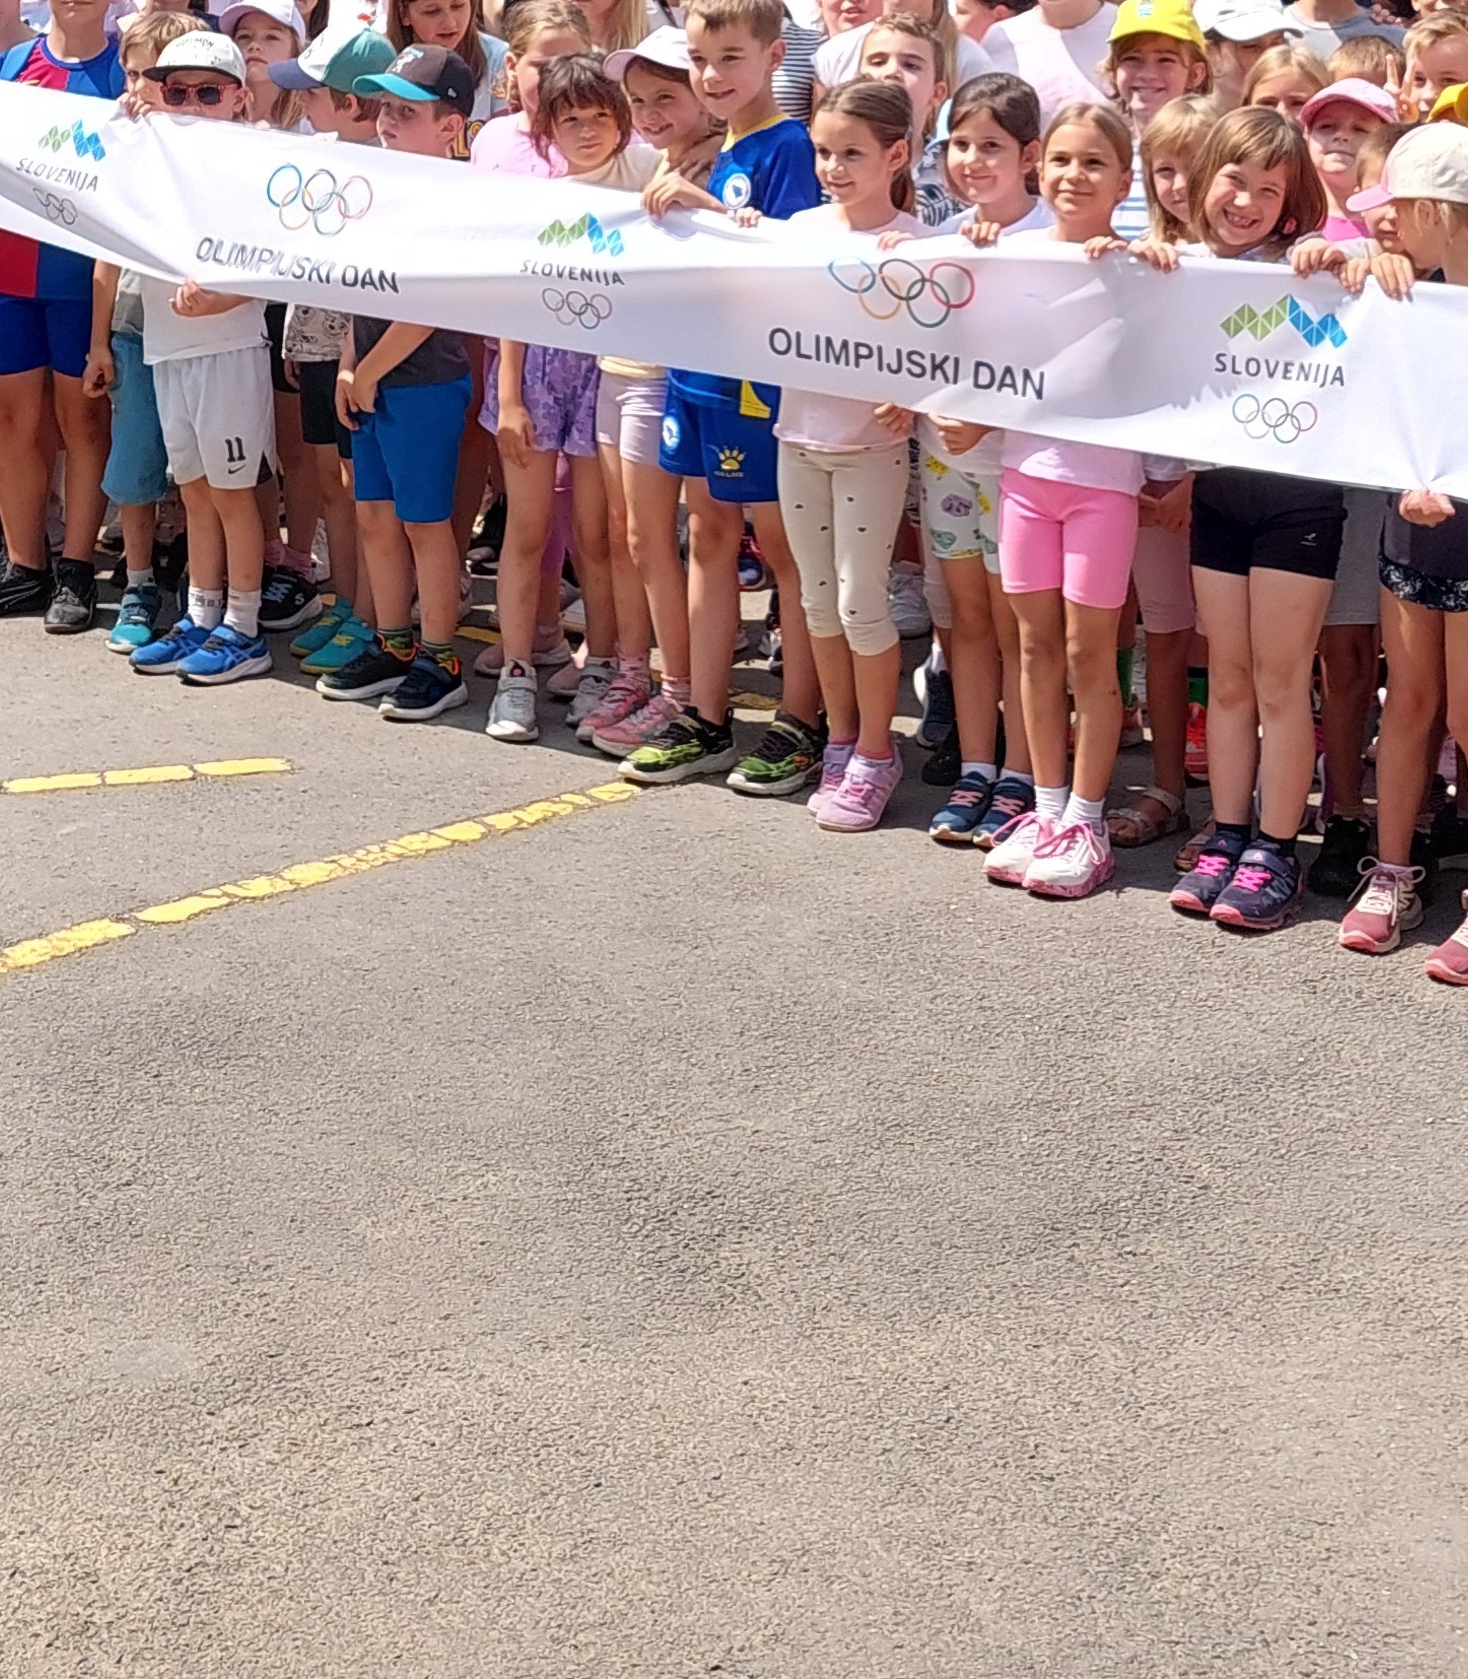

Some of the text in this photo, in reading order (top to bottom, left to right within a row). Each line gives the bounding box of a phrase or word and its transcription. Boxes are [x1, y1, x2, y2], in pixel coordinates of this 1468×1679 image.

[16, 158, 99, 192] SLOVENIJA
[196, 237, 400, 294] OLIMPIJSKI DAN
[519, 259, 626, 287] SLOVENIJA
[769, 328, 1045, 400] OLIMPIJSKI DAN
[1214, 352, 1345, 388] SLOVENIJA
[225, 436, 246, 463] 11
